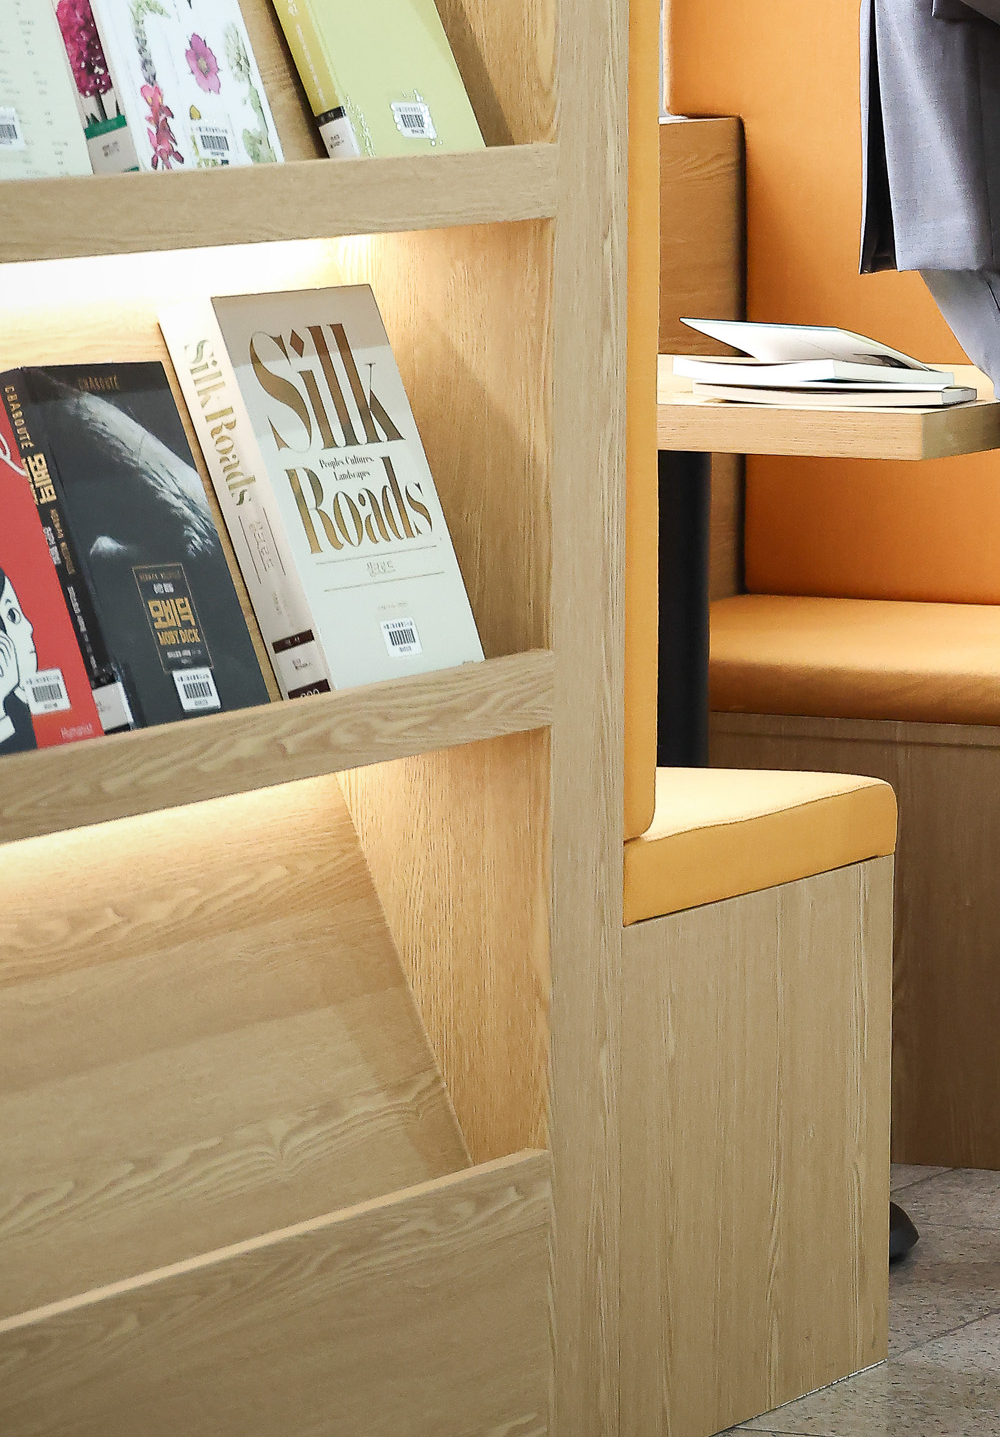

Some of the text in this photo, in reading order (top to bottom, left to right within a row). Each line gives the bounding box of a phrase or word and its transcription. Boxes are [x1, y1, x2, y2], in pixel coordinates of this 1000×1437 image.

[183, 339, 257, 507] Silk Roads
[249, 323, 406, 453] Silk
[284, 455, 435, 555] Roads
[179, 628, 201, 644] DICK
